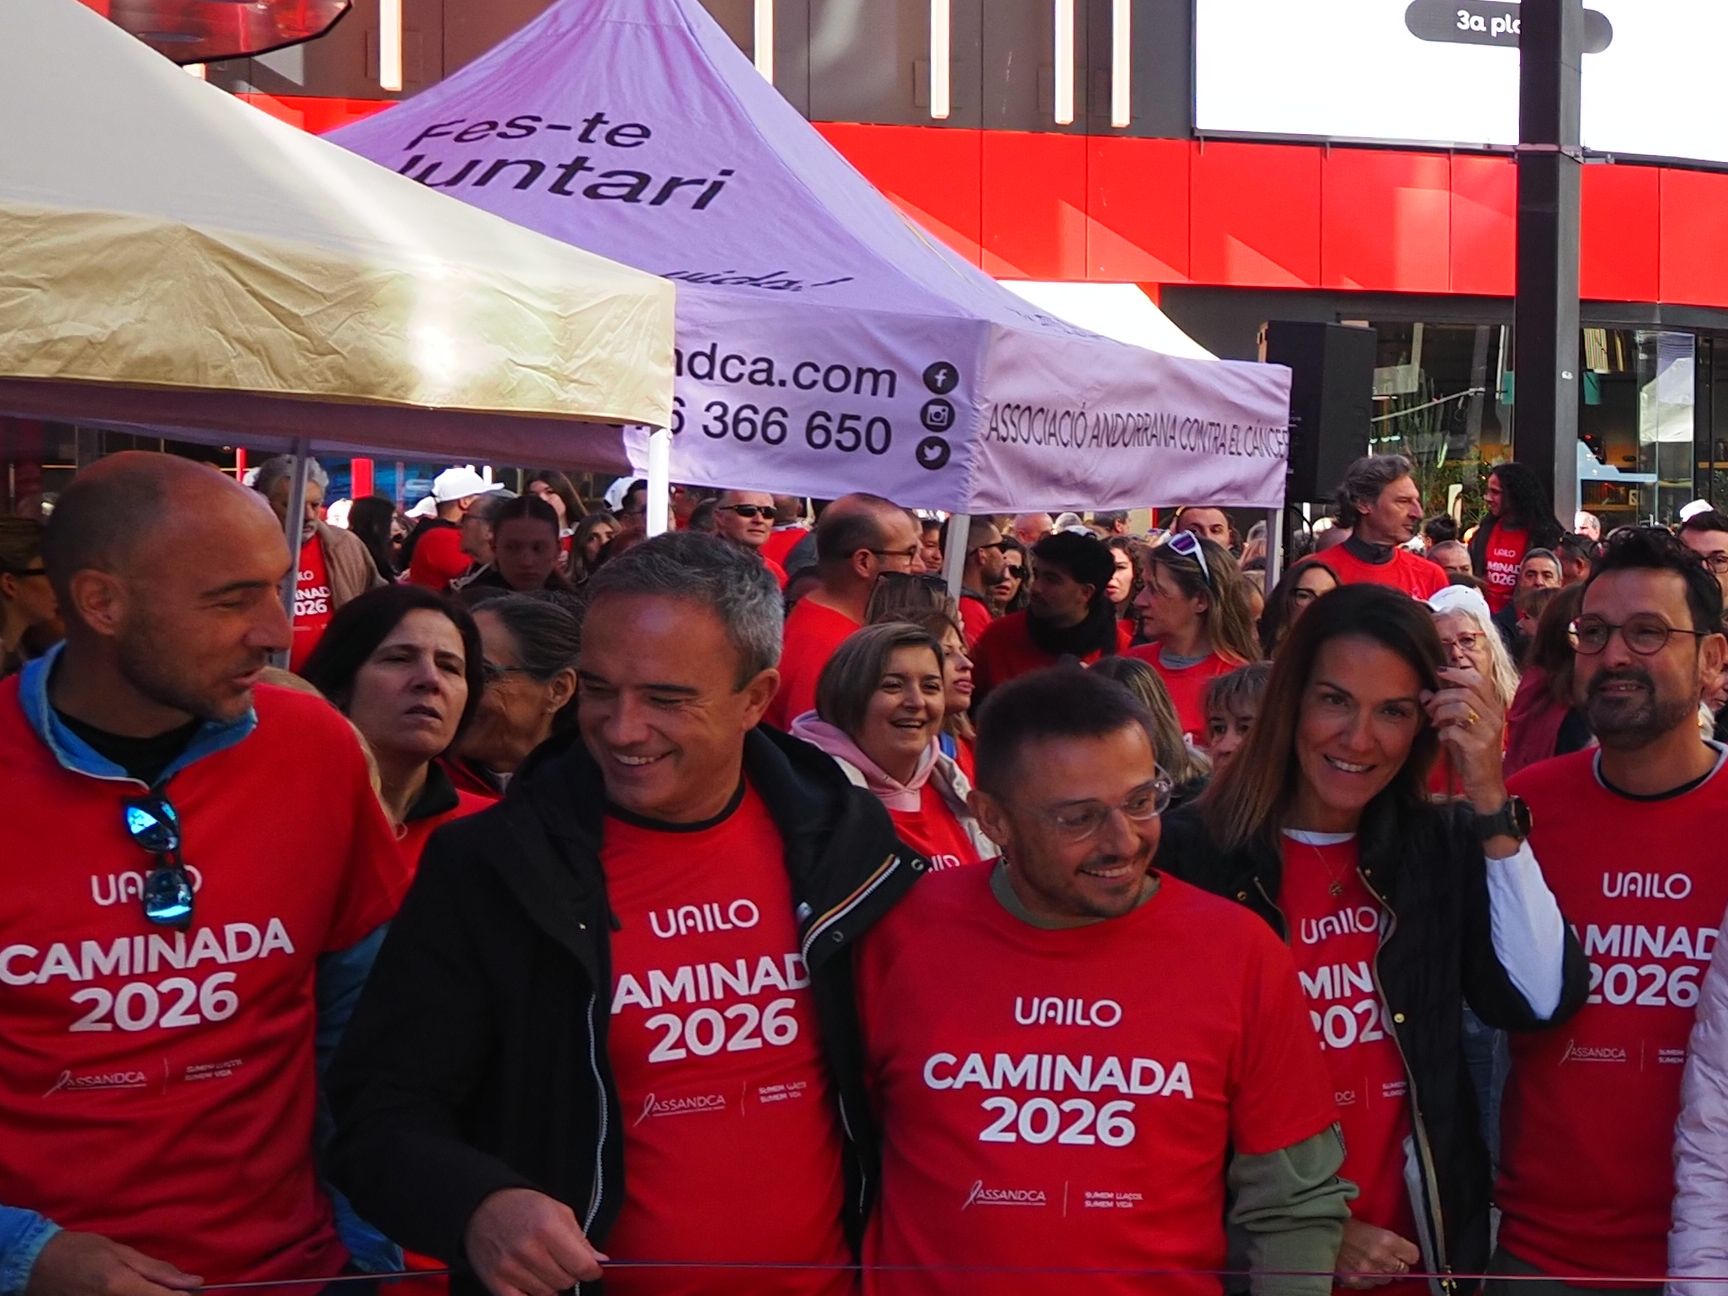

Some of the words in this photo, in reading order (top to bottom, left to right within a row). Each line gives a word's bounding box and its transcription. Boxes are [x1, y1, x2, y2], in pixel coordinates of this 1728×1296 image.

[702, 400, 788, 445] 366
[805, 410, 892, 455] 650
[986, 401, 1087, 449] ASSOCIACIÓ
[1088, 410, 1178, 450] ANDORRANA
[1178, 417, 1227, 455] CONTRA
[1229, 423, 1243, 456] EL
[294, 598, 328, 616] 026
[1602, 871, 1692, 900] UAILO
[648, 898, 760, 939] UAILO
[1300, 905, 1378, 944] UAILO
[0, 917, 295, 986] CAMINADA
[1569, 923, 1720, 962] MINAD
[68, 970, 239, 1033] 2026
[611, 952, 812, 1015] AMINAD
[645, 998, 798, 1064] 2026
[1014, 996, 1122, 1028] UAILO
[923, 1051, 1193, 1100] CAMINADA
[652, 1094, 726, 1112] ASSANDCA
[979, 1096, 1136, 1147] 2026
[977, 1189, 1046, 1201] ASSANDCA
